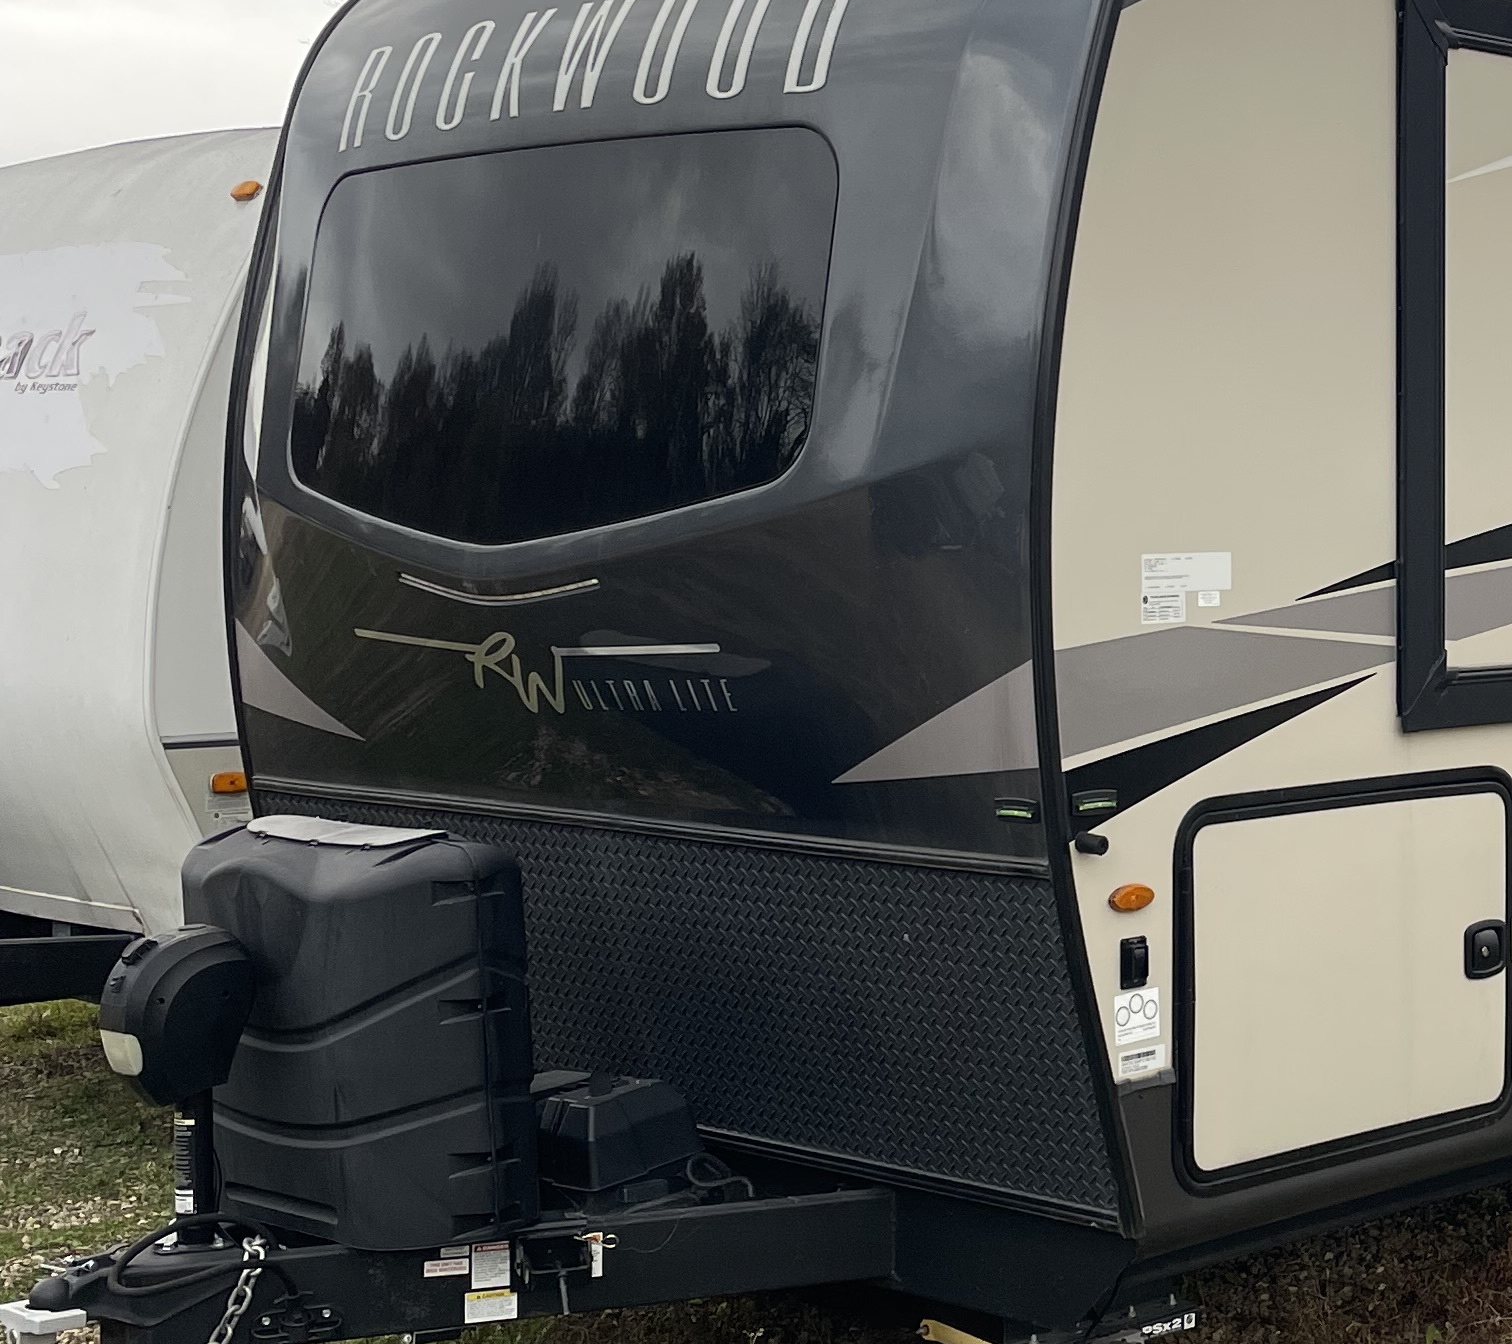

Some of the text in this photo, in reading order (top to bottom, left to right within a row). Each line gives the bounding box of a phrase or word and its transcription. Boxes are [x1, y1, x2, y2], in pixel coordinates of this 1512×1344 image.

[0, 311, 97, 380] ack
[465, 630, 738, 714] RW ULTRA LITE
